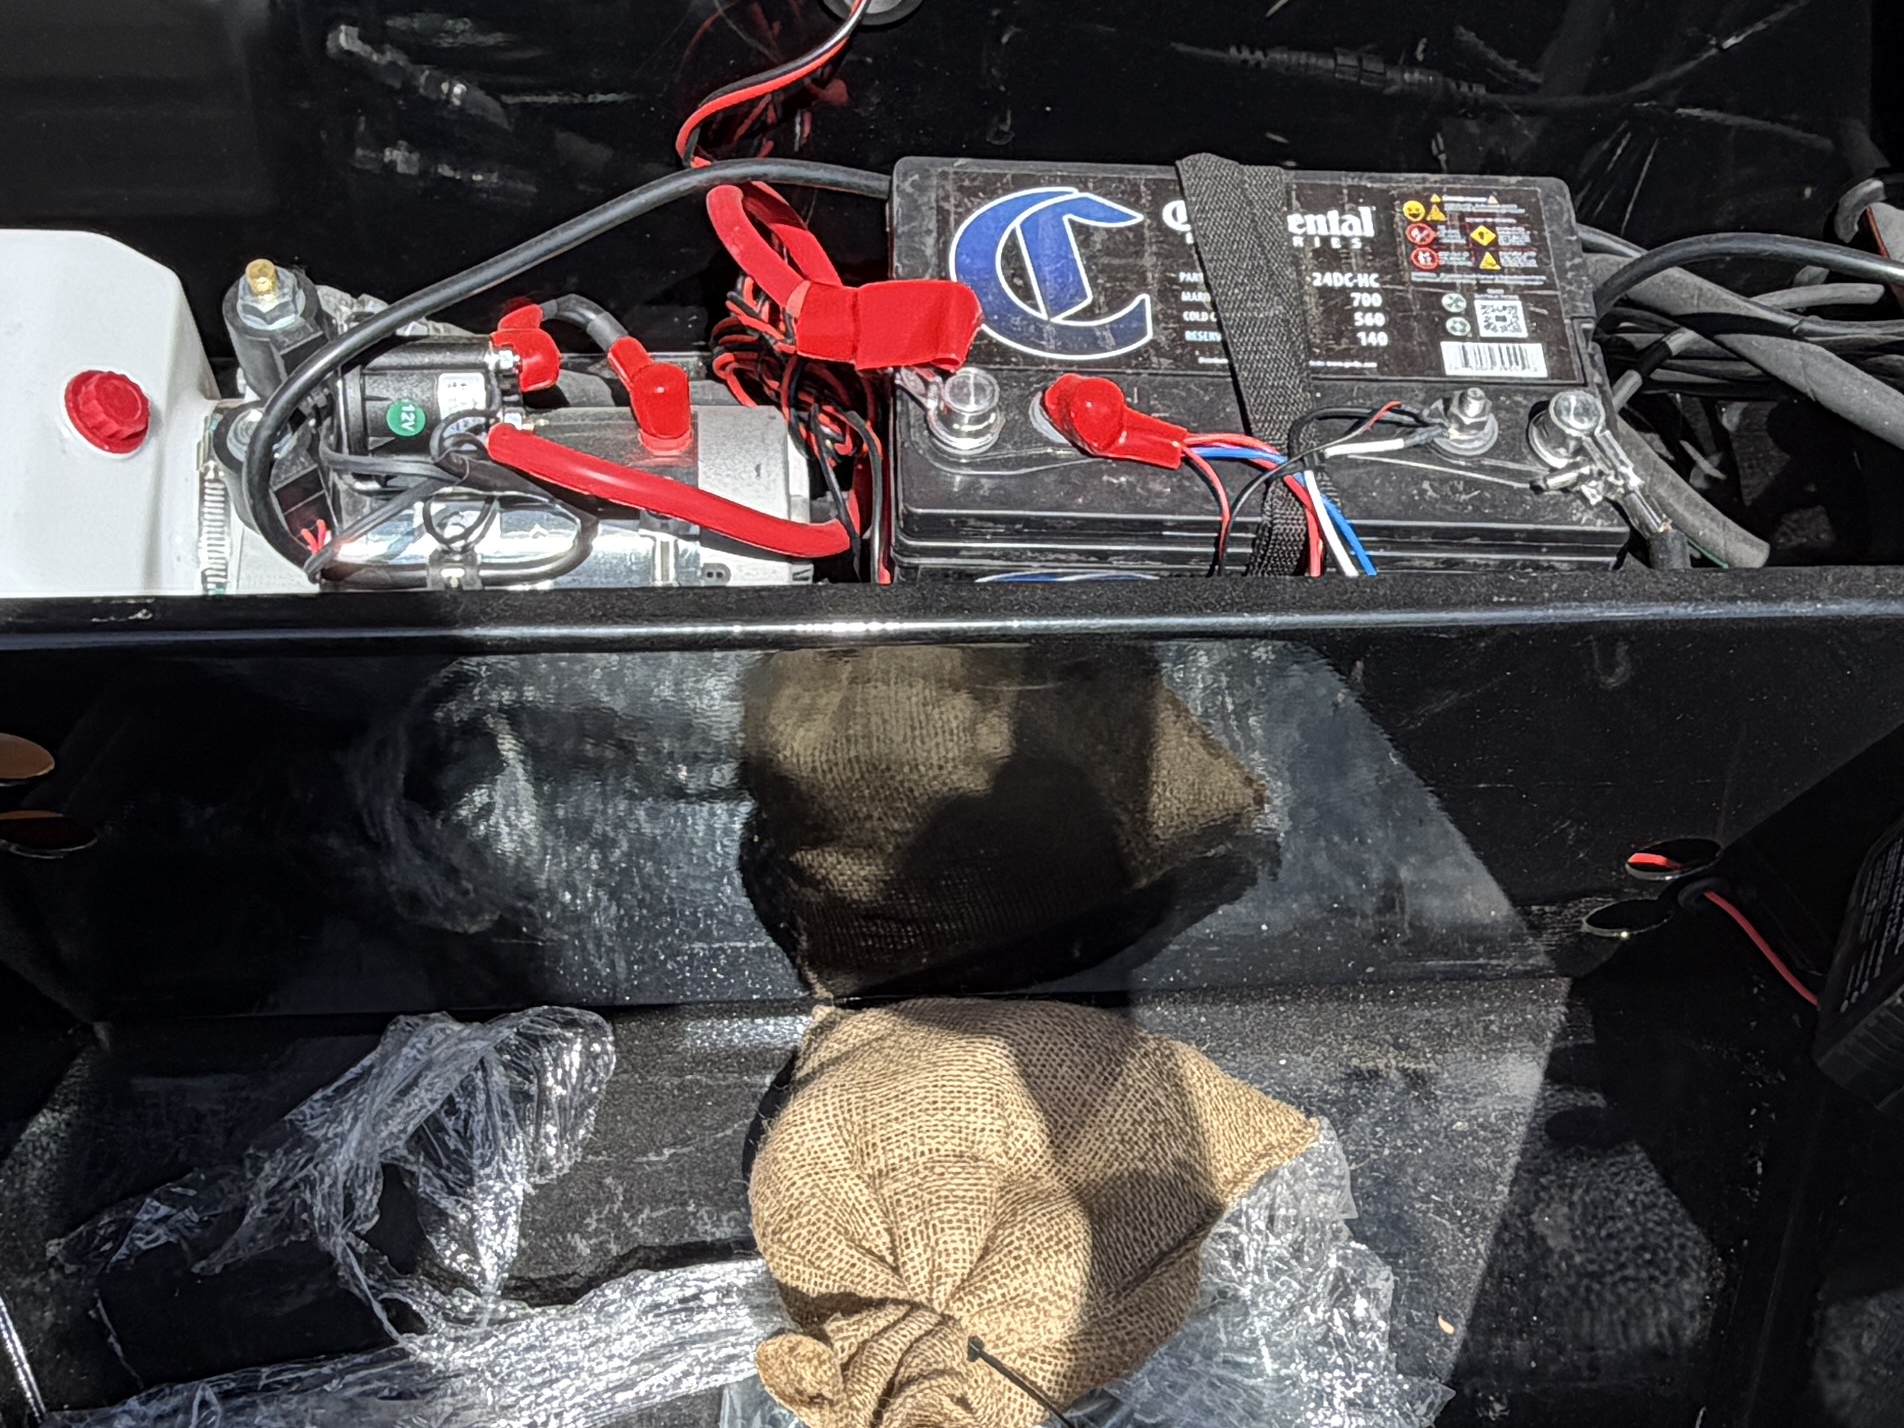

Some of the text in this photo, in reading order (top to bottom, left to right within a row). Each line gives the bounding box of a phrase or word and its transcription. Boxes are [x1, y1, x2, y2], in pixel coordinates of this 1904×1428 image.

[1350, 291, 1383, 308] 700
[1353, 310, 1386, 328] 560
[1356, 330, 1389, 347] 140
[400, 404, 416, 432] 12V
